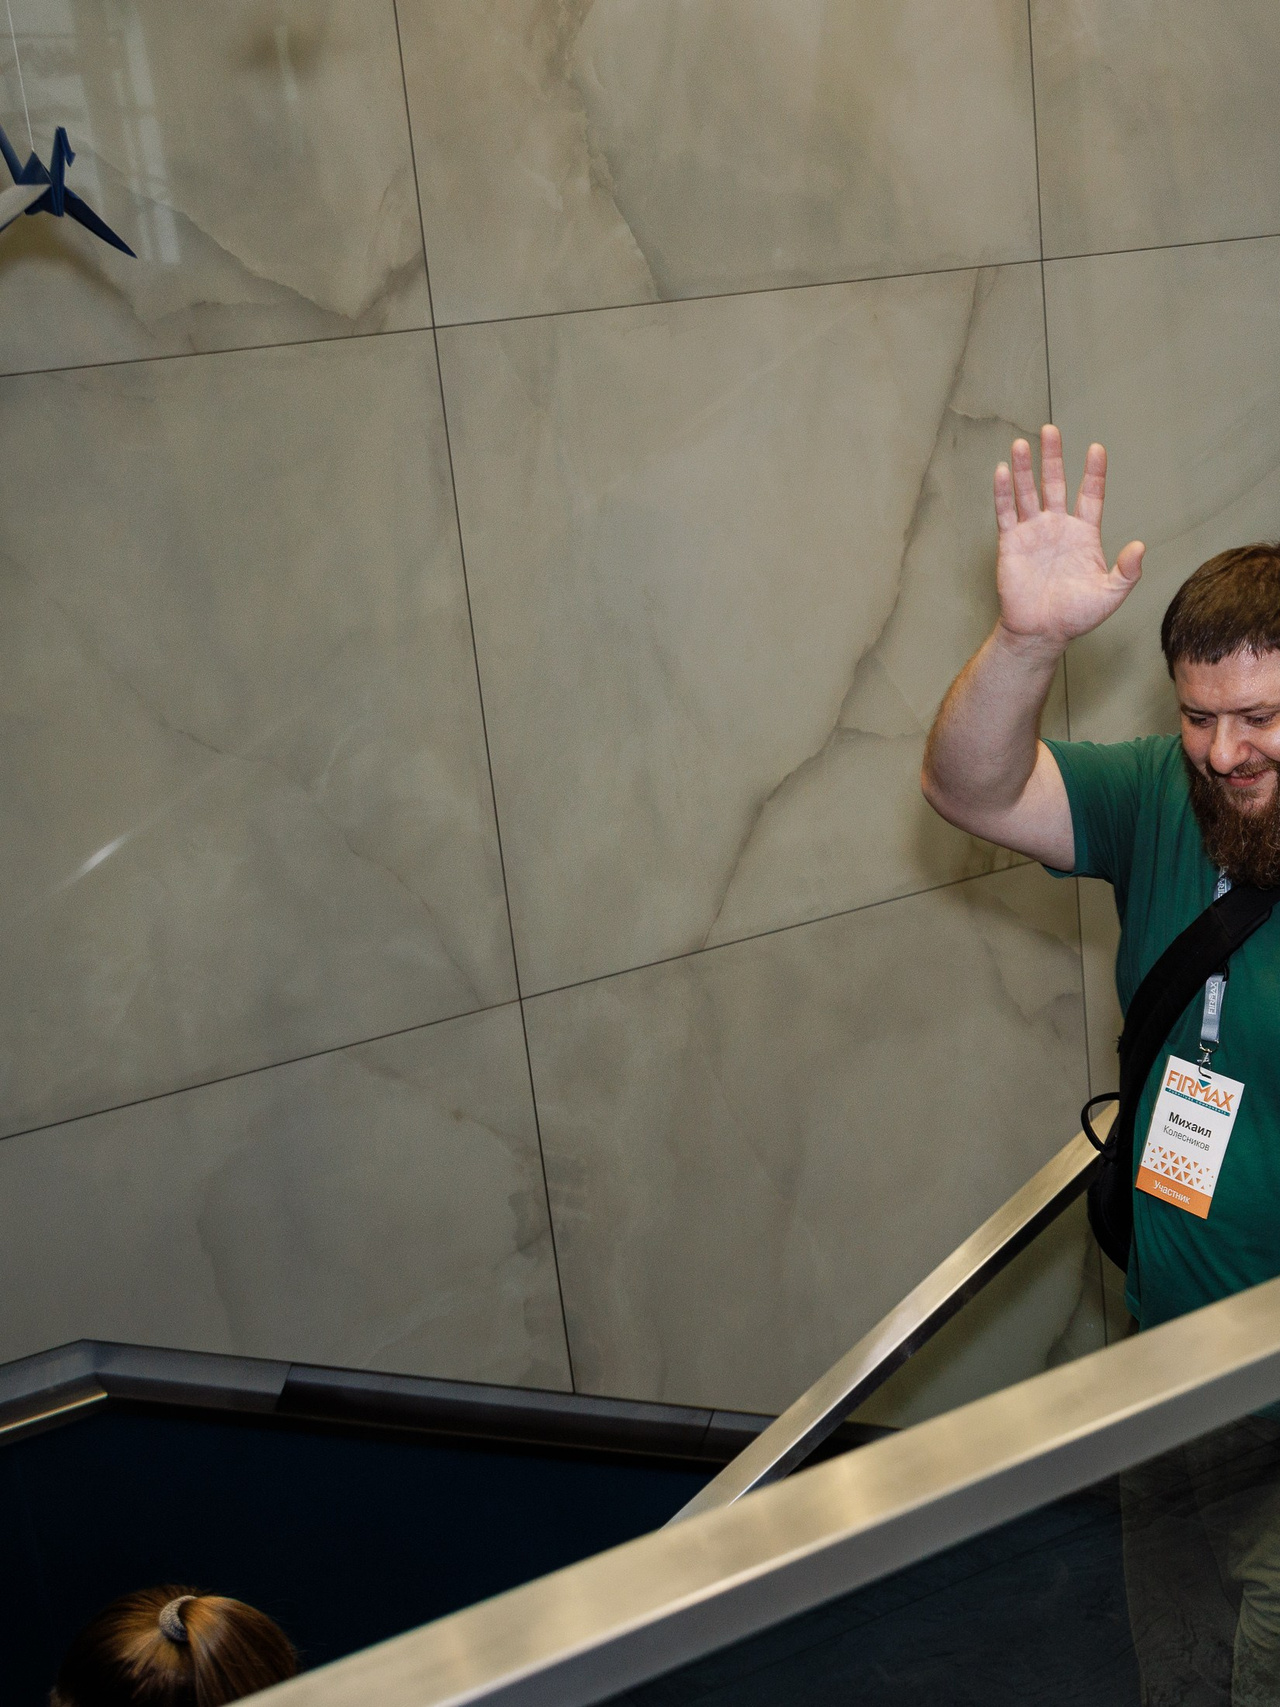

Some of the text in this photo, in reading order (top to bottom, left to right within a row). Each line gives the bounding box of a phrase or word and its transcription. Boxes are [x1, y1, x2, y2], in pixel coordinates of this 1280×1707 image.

[1207, 981, 1219, 1015] FIRMAX
[1166, 1070, 1235, 1112] FIRMAX
[1163, 1124, 1211, 1152] Колесников
[1168, 1111, 1212, 1139] Михаил
[1153, 1179, 1191, 1205] Участник
